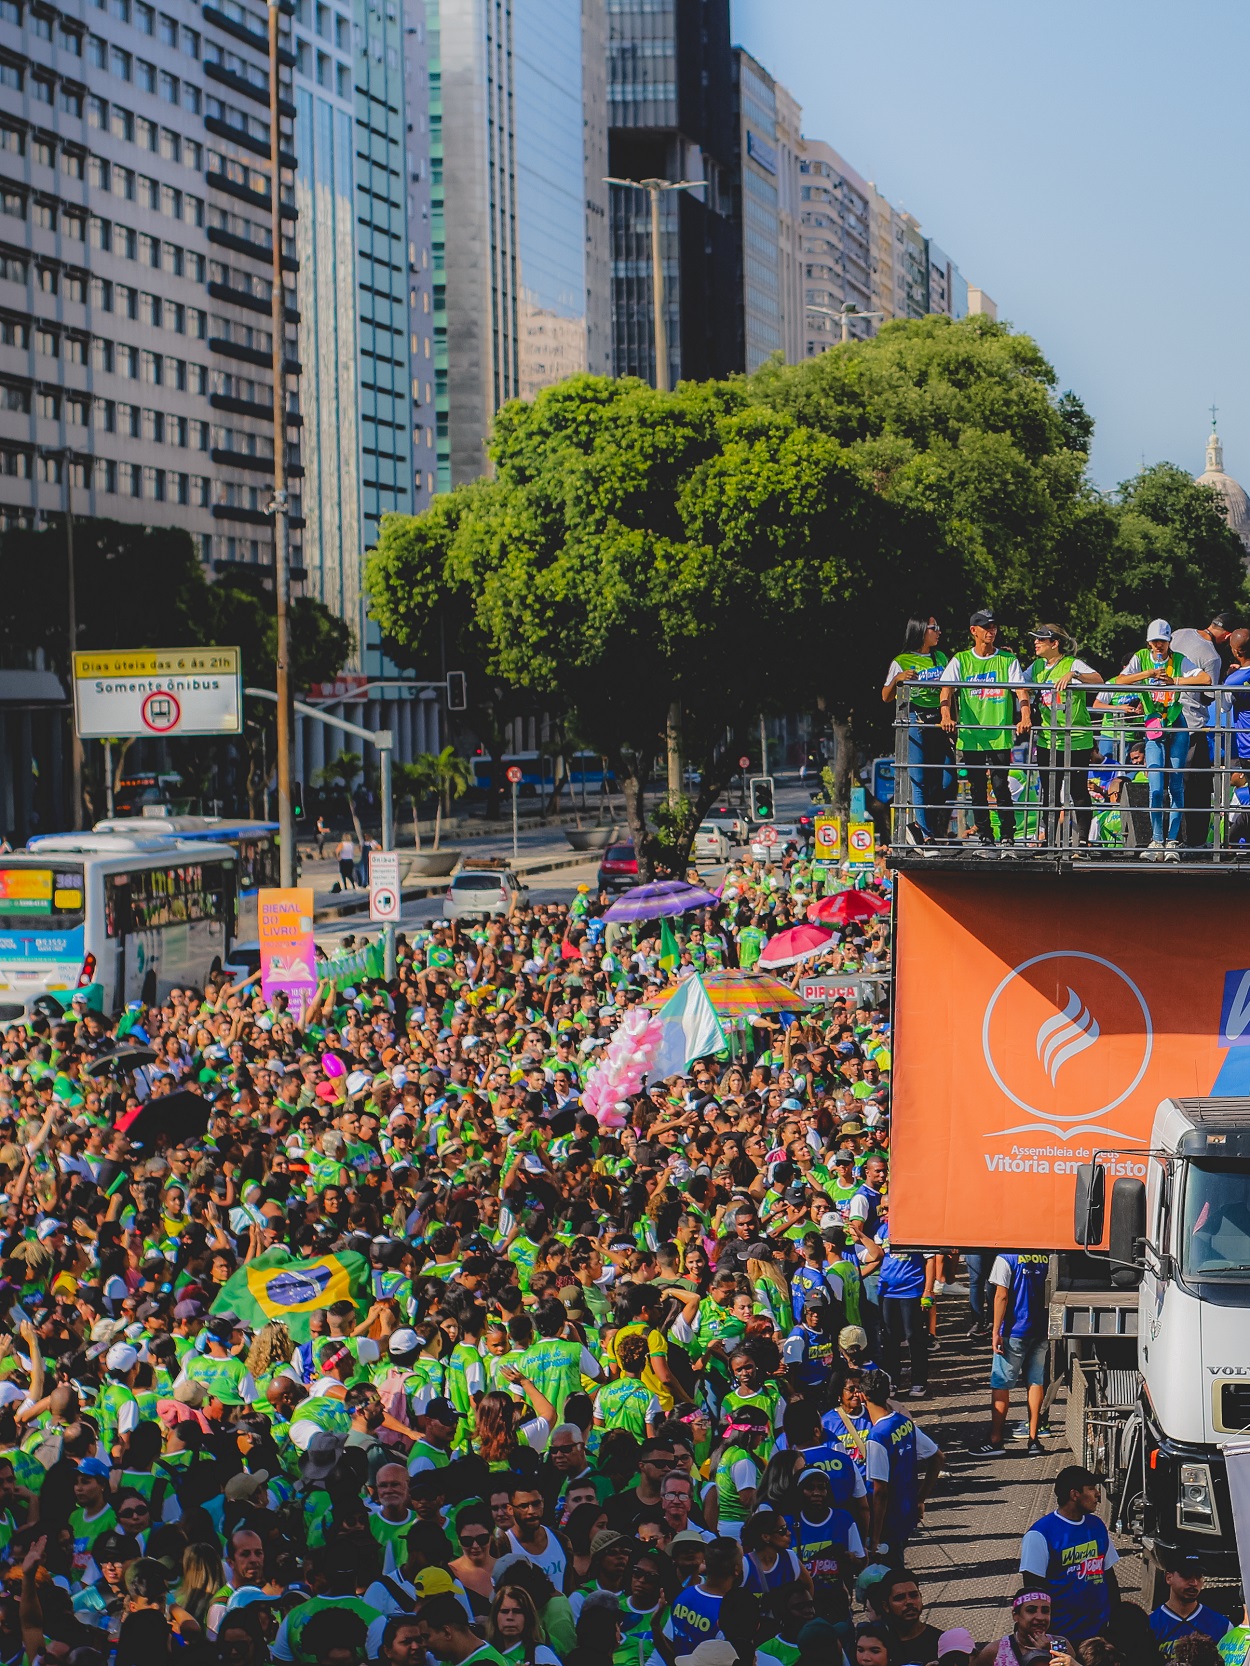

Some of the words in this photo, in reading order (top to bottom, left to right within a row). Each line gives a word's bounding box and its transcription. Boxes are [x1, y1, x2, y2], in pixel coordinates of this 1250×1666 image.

[82, 661, 109, 671] Dias
[114, 659, 146, 671] úteis
[151, 659, 171, 670] das
[177, 658, 185, 669] 6
[191, 657, 204, 668] às
[209, 657, 231, 668] 21h
[95, 681, 162, 693] Somente
[167, 678, 220, 692] ônibus
[262, 903, 302, 914] BIENAL
[263, 915, 279, 925] DO
[263, 926, 298, 936] LIVRO
[1011, 1144, 1073, 1157] Assembleia
[1075, 1146, 1090, 1158] de
[984, 1152, 1050, 1174] Vitória
[1018, 1254, 1049, 1265] APOIO
[890, 1419, 913, 1445] APOIO
[1062, 1542, 1096, 1565] Marcha
[1066, 1564, 1081, 1576] para
[1077, 1557, 1104, 1580] Jesus
[672, 1603, 711, 1632] APOIO
